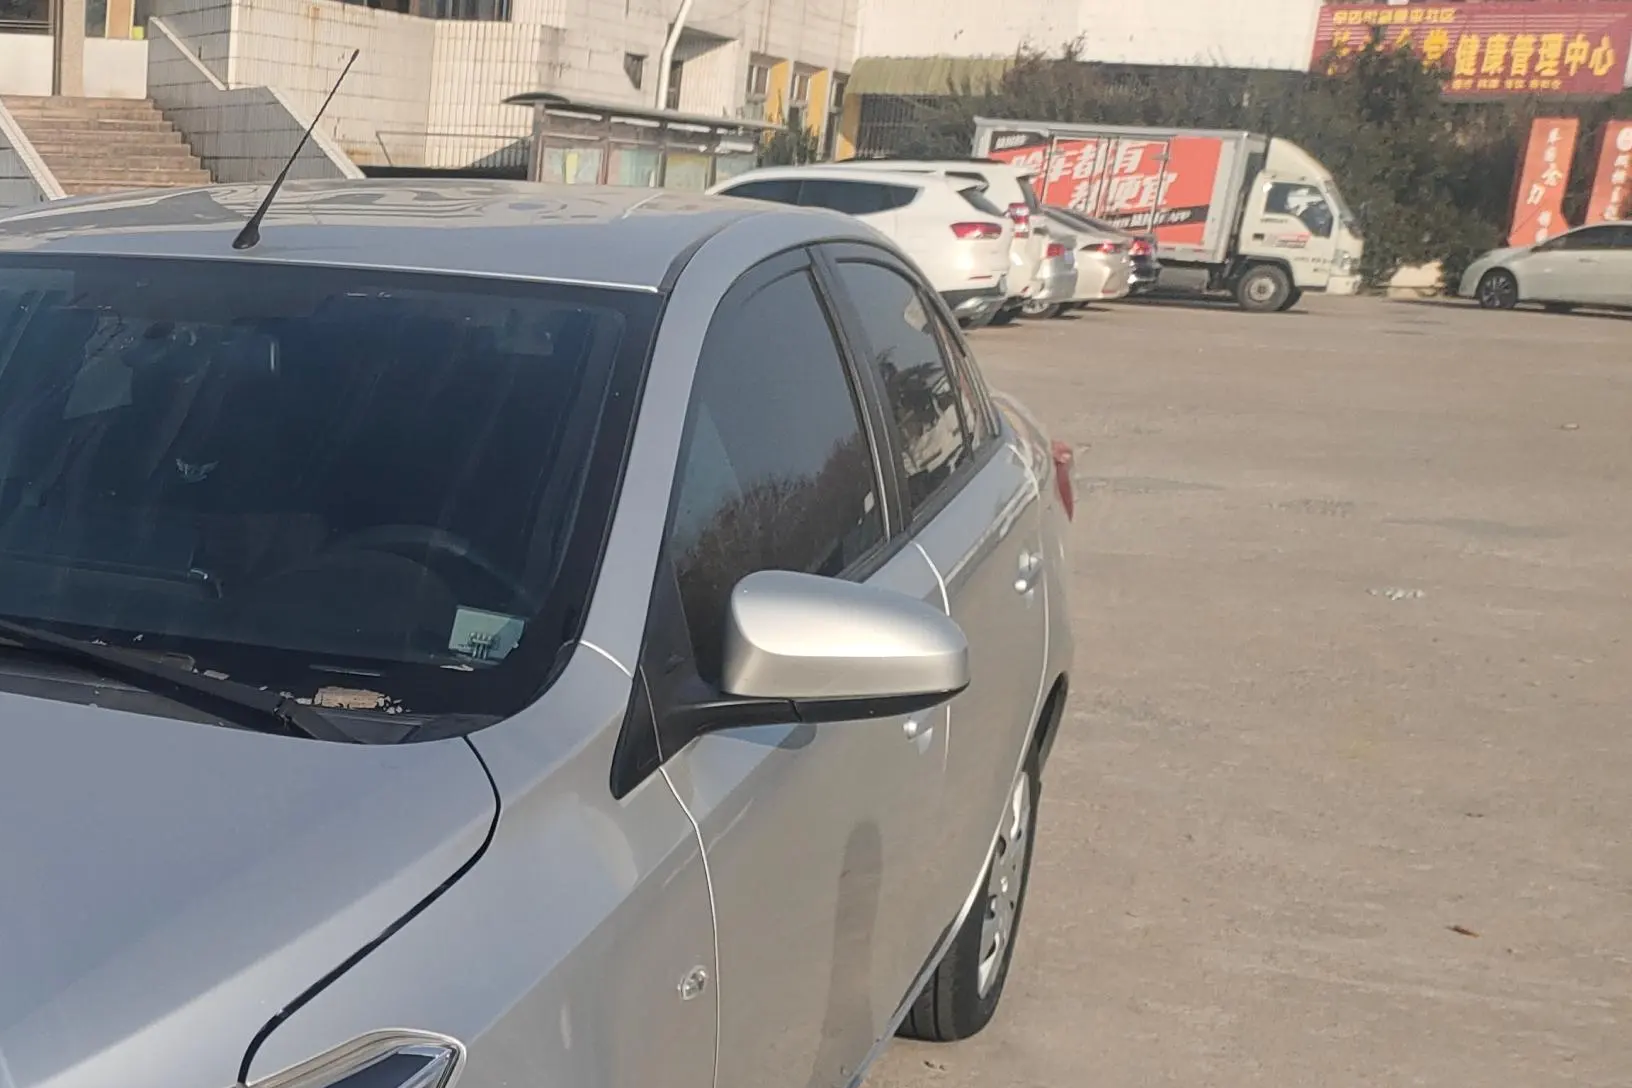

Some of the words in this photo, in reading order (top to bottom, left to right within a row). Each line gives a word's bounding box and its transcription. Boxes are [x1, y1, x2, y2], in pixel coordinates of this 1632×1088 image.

[1454, 32, 1616, 77] 健康管理中心
